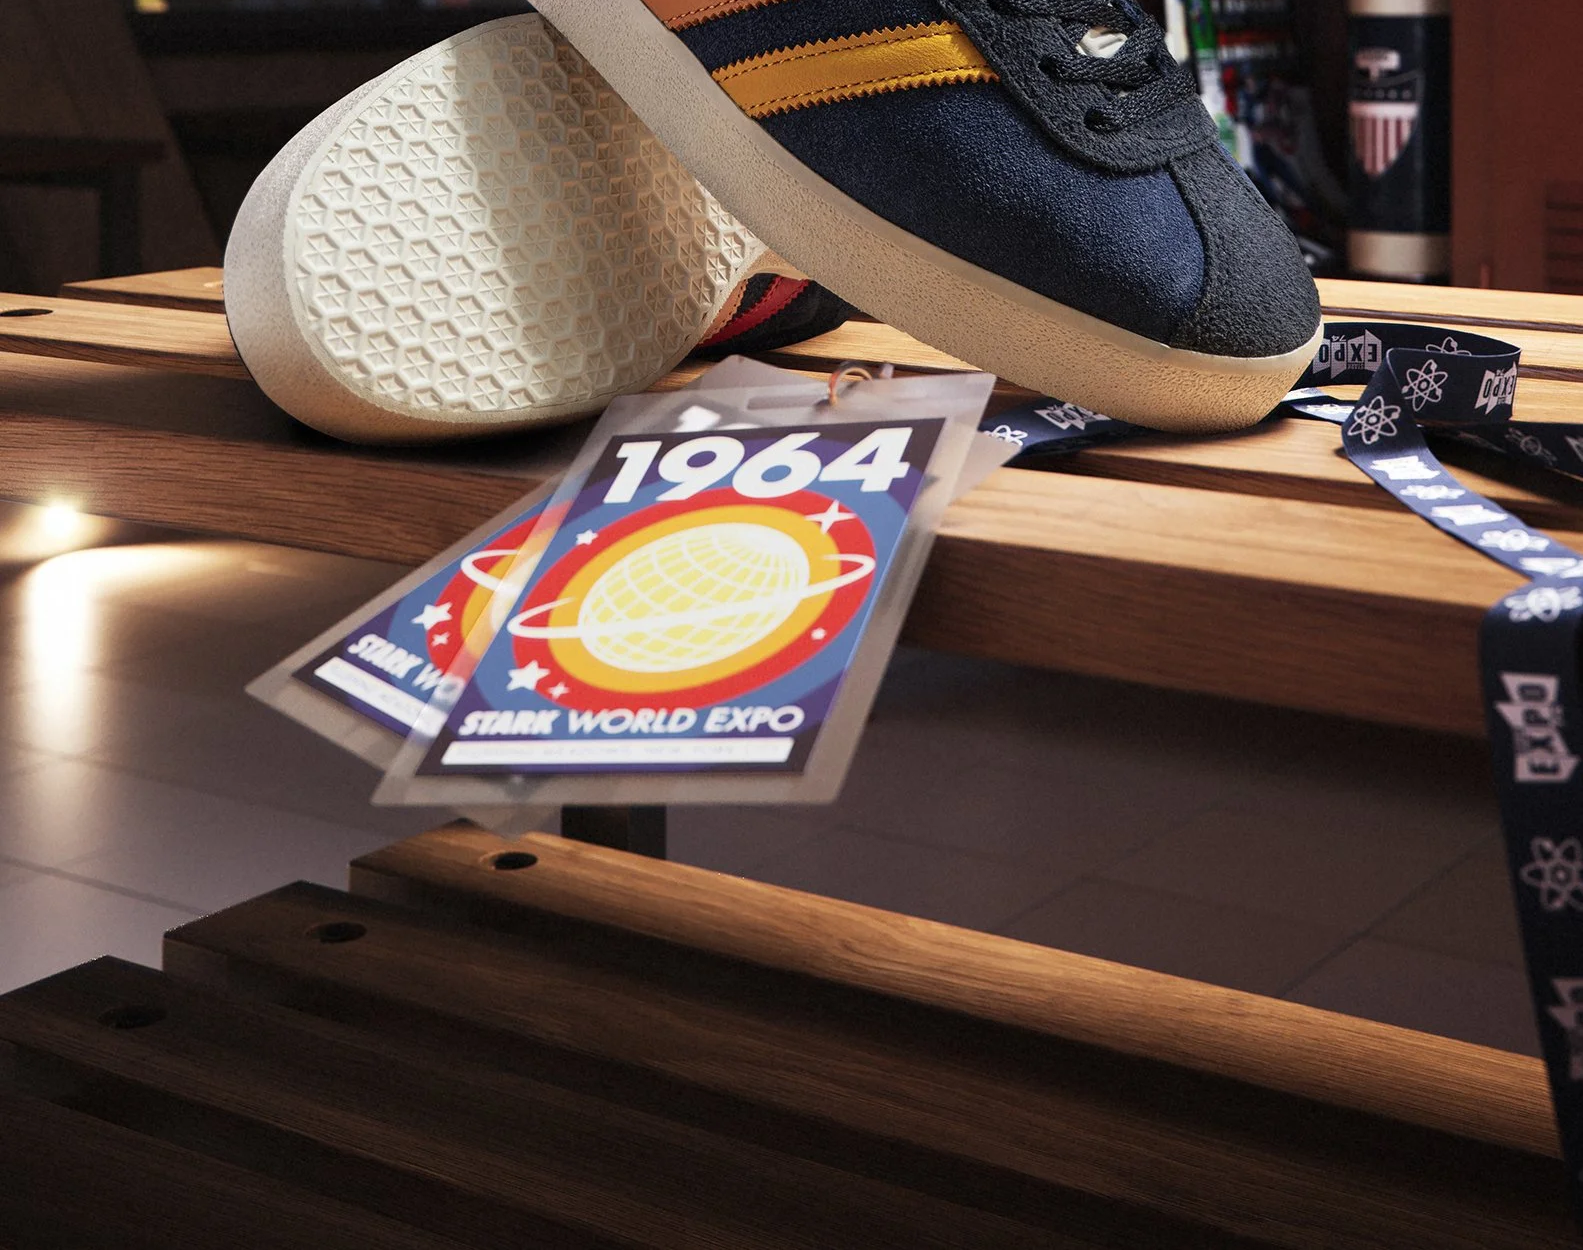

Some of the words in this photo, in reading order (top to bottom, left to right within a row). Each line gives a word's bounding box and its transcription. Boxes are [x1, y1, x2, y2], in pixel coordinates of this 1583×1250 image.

[1319, 343, 1378, 363] EXPO
[1483, 375, 1516, 399] EXPO
[603, 427, 913, 504] 1964
[347, 633, 425, 680] STARK
[458, 710, 561, 736] STARK
[568, 707, 698, 735] WORLD
[703, 705, 805, 733] EXPO
[1516, 683, 1561, 775] EXPO
